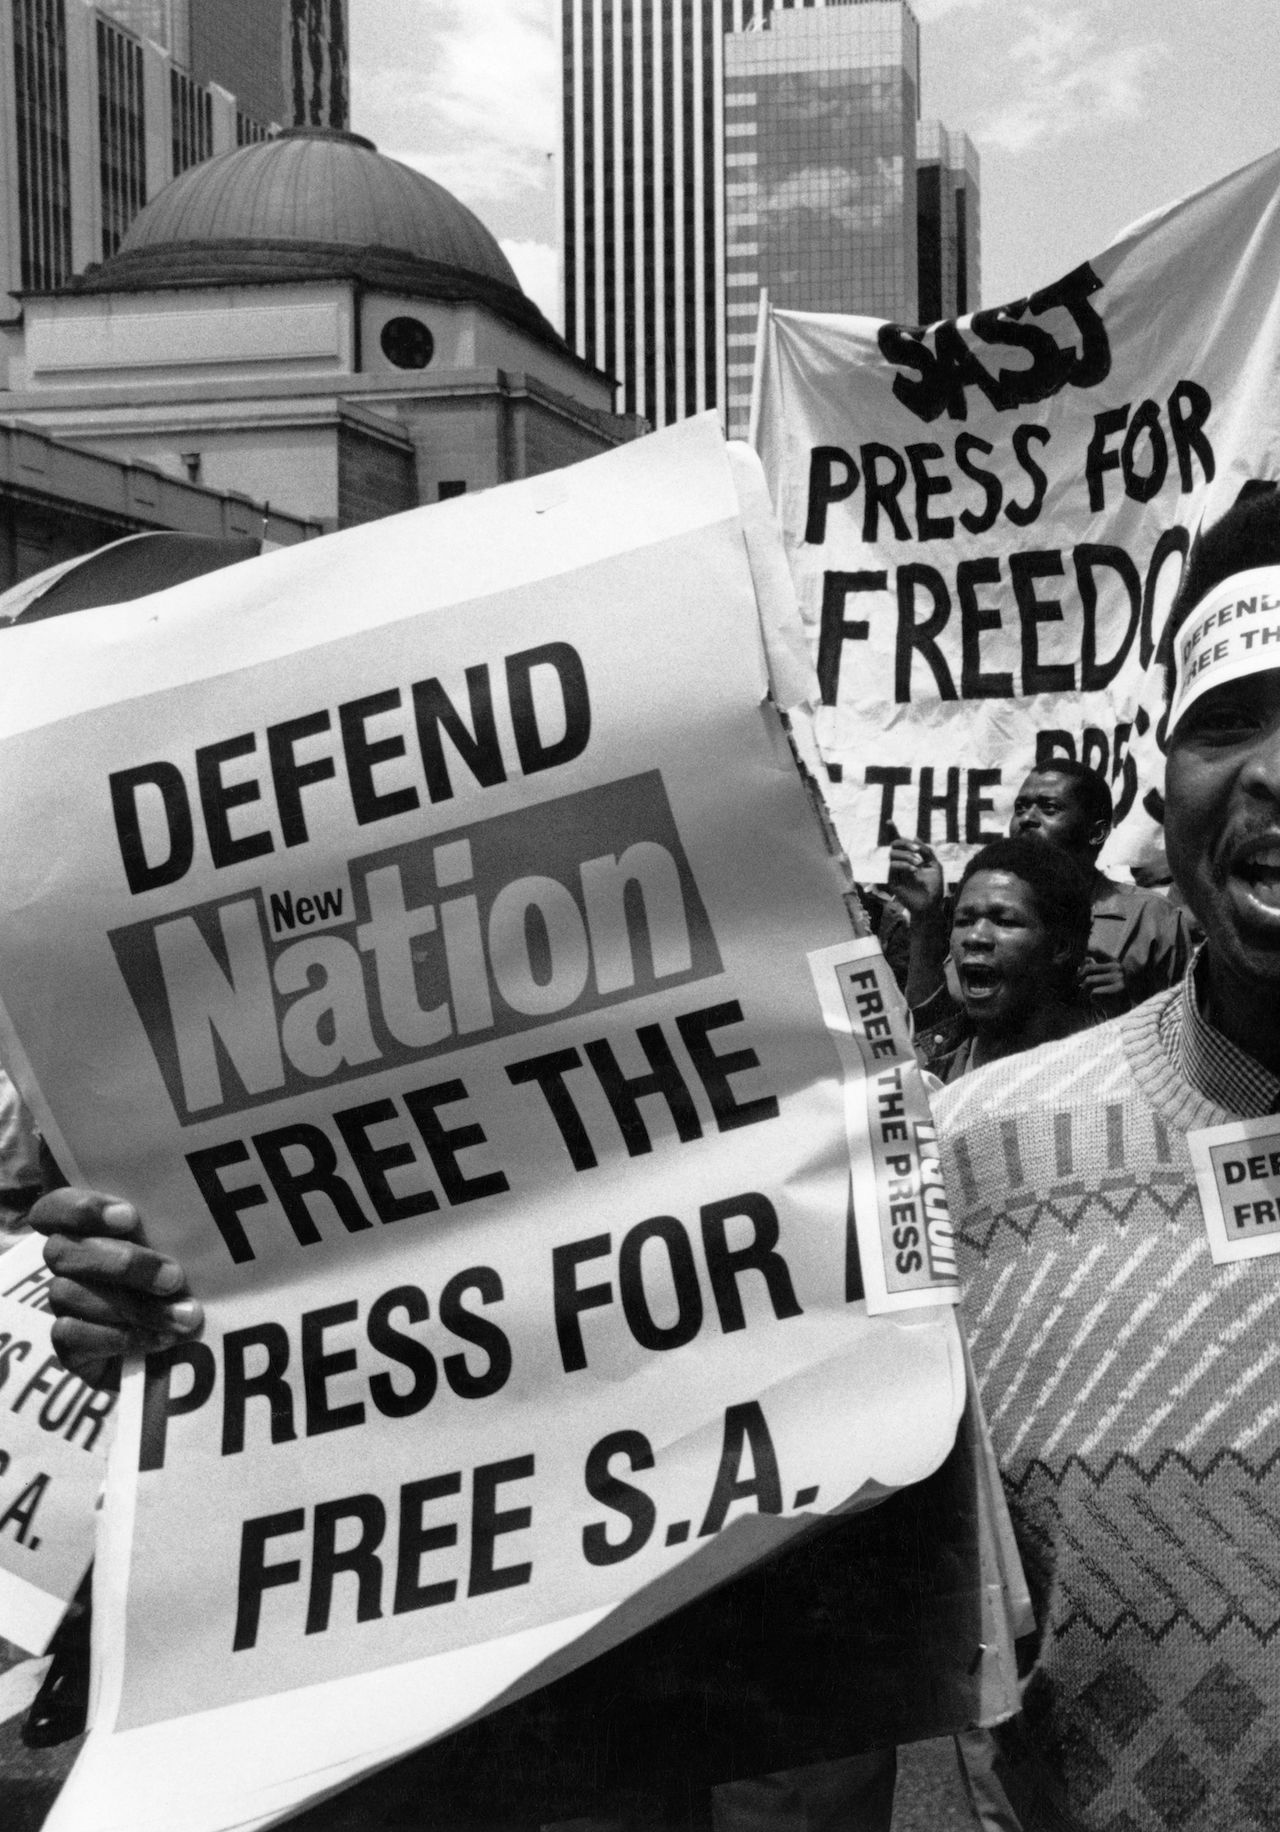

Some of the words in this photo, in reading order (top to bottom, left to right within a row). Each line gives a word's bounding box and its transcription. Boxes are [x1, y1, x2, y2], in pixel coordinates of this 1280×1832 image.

[877, 261, 1111, 423] SASJ
[804, 423, 1052, 545] PRESS
[1085, 379, 1216, 513] FOR
[816, 524, 1192, 708] FREEDO
[109, 640, 592, 896] DEFEND
[865, 763, 1009, 847] THE
[152, 838, 694, 1113] Nation
[268, 883, 344, 934] New
[849, 968, 898, 1060] FREE
[184, 1079, 510, 1264] FREE
[504, 1000, 780, 1173] THE
[877, 1068, 909, 1144] THE
[885, 1153, 923, 1276] PRESS
[9, 1352, 119, 1452] FOR
[138, 1265, 514, 1472] PRESS
[551, 1191, 804, 1374] FOR
[232, 1452, 536, 1653] FREE
[581, 1400, 821, 1567] S.A.
